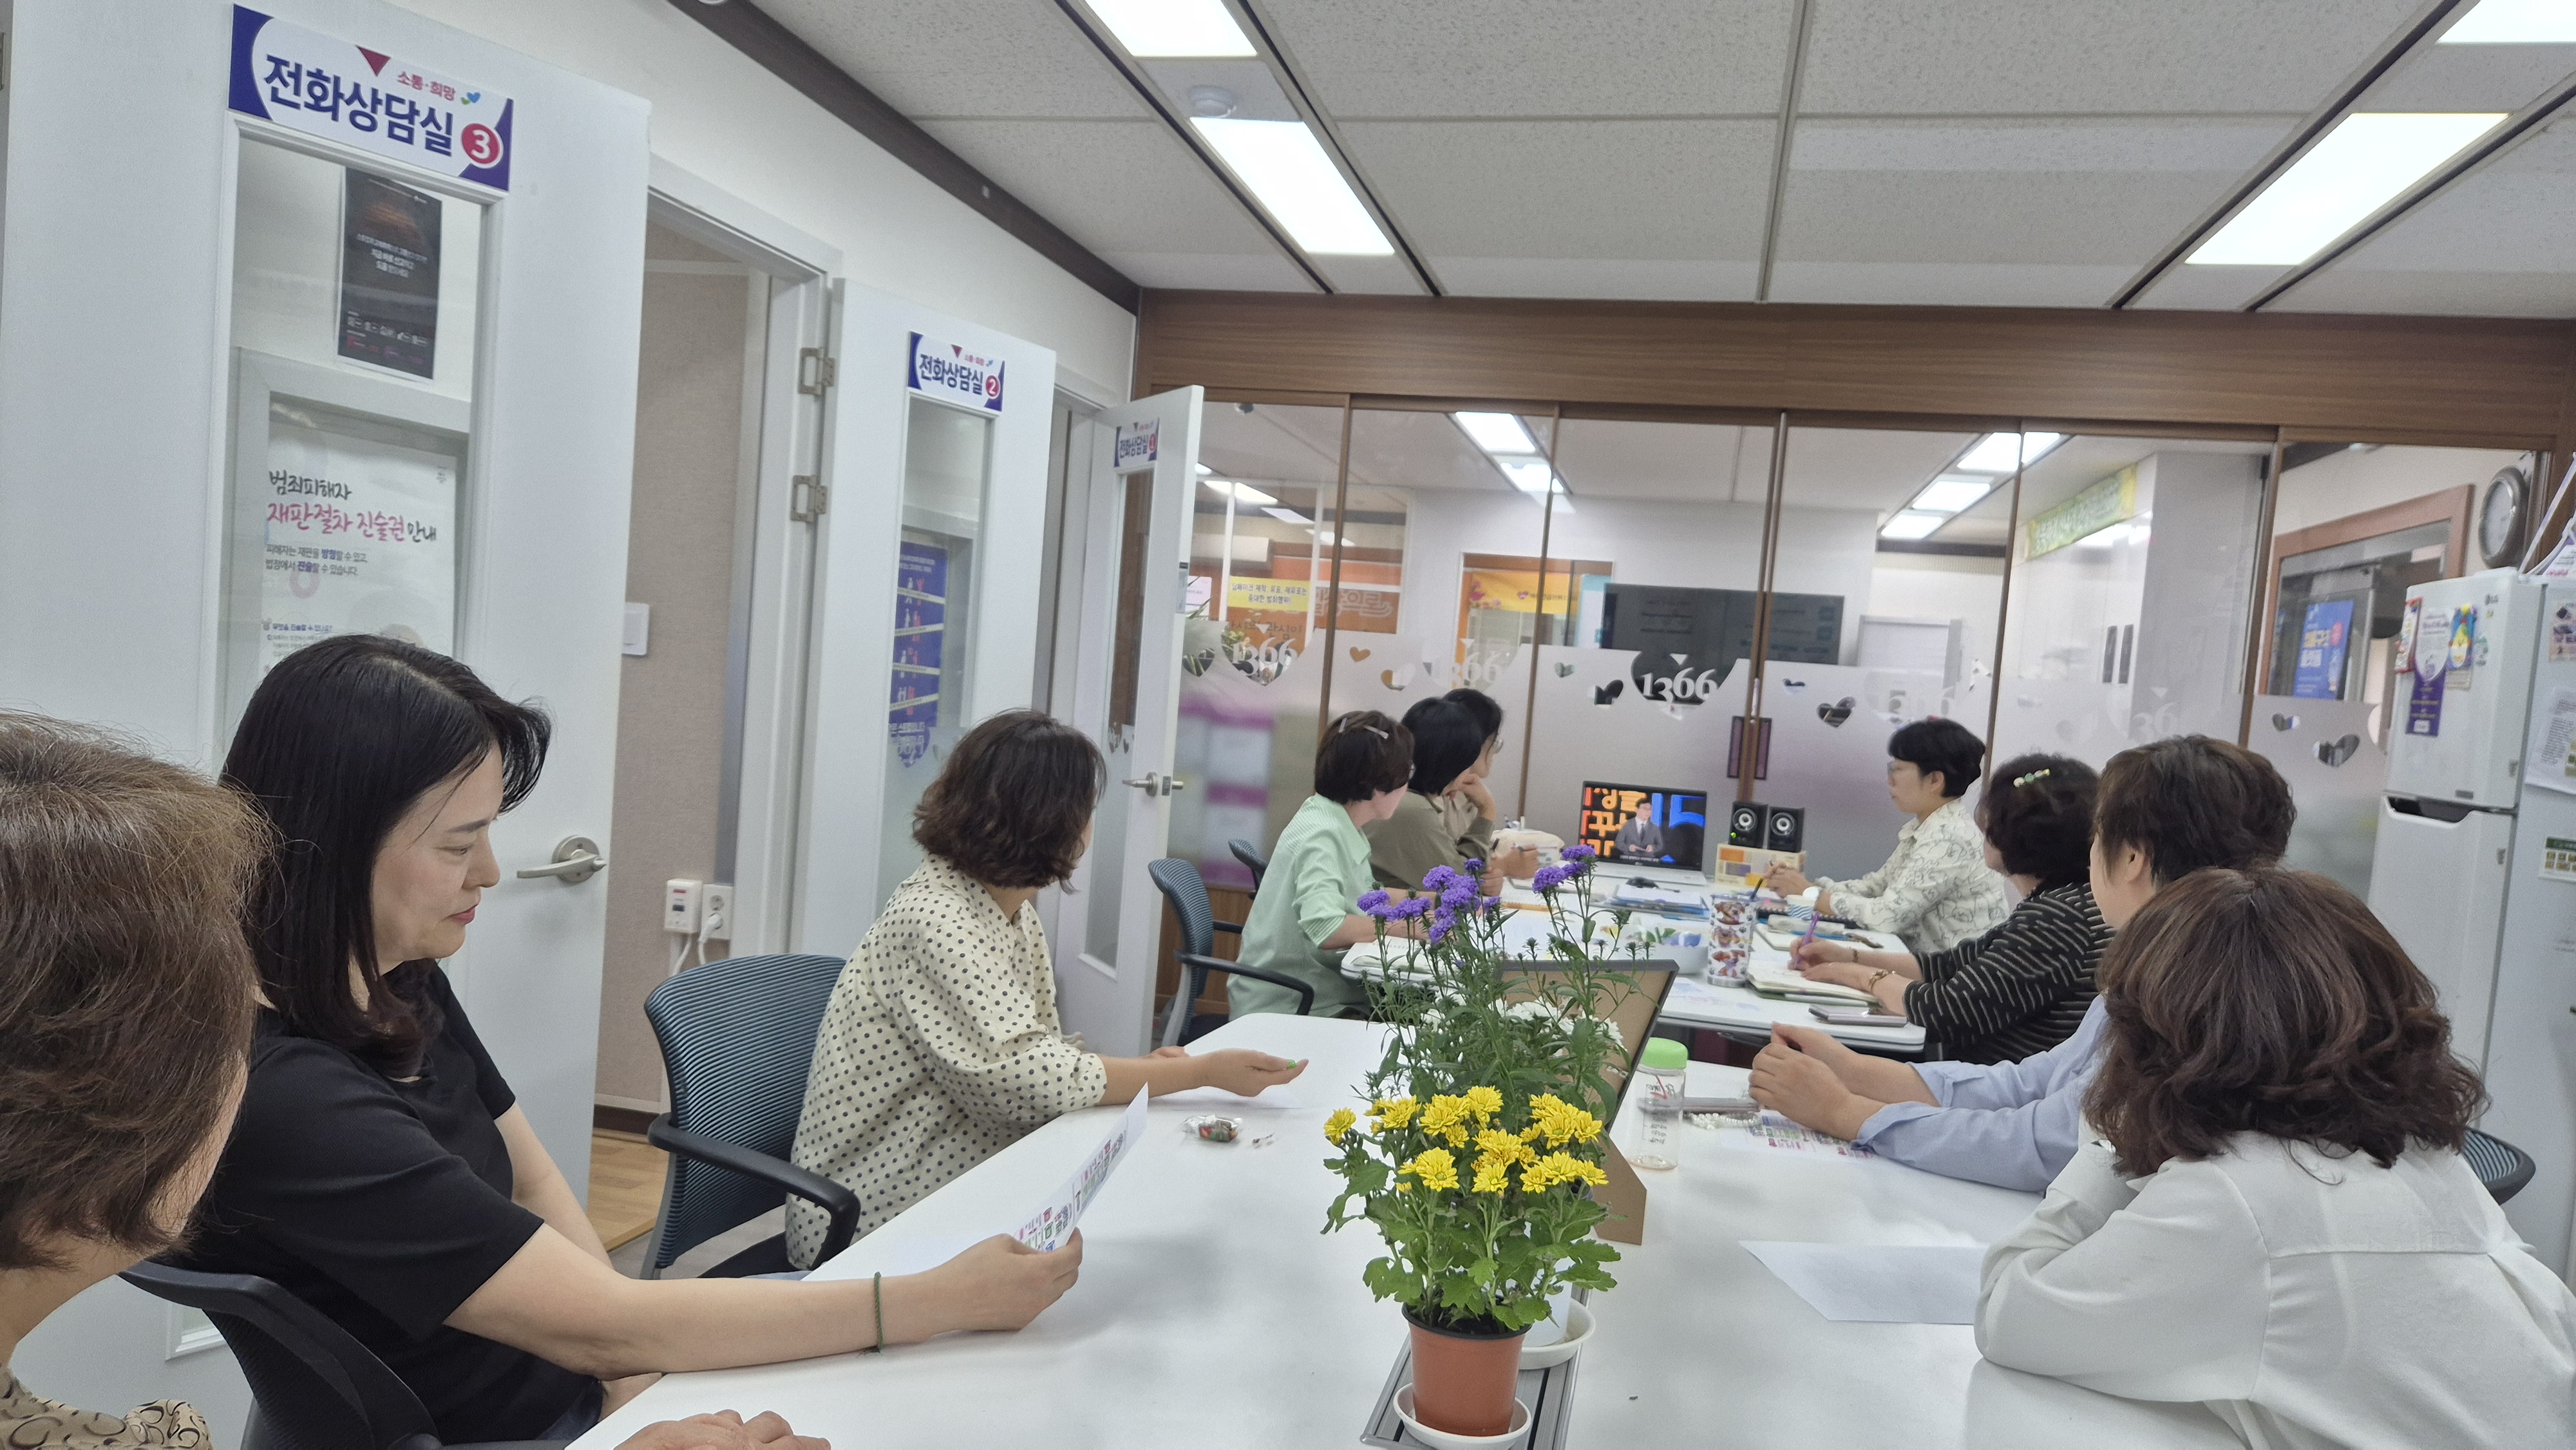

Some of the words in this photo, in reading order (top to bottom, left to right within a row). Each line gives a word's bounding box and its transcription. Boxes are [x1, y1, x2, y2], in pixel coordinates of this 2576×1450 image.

[263, 53, 453, 158] 전화상담실
[471, 129, 491, 159] 3
[918, 353, 983, 395] 전화상담실
[1119, 435, 1148, 459] 전화상담실
[269, 469, 352, 500] 범죄피해자
[267, 502, 354, 534] 재판절차
[357, 511, 404, 541] 진술권
[407, 520, 437, 542] 안내
[1640, 666, 1718, 700] 1366
